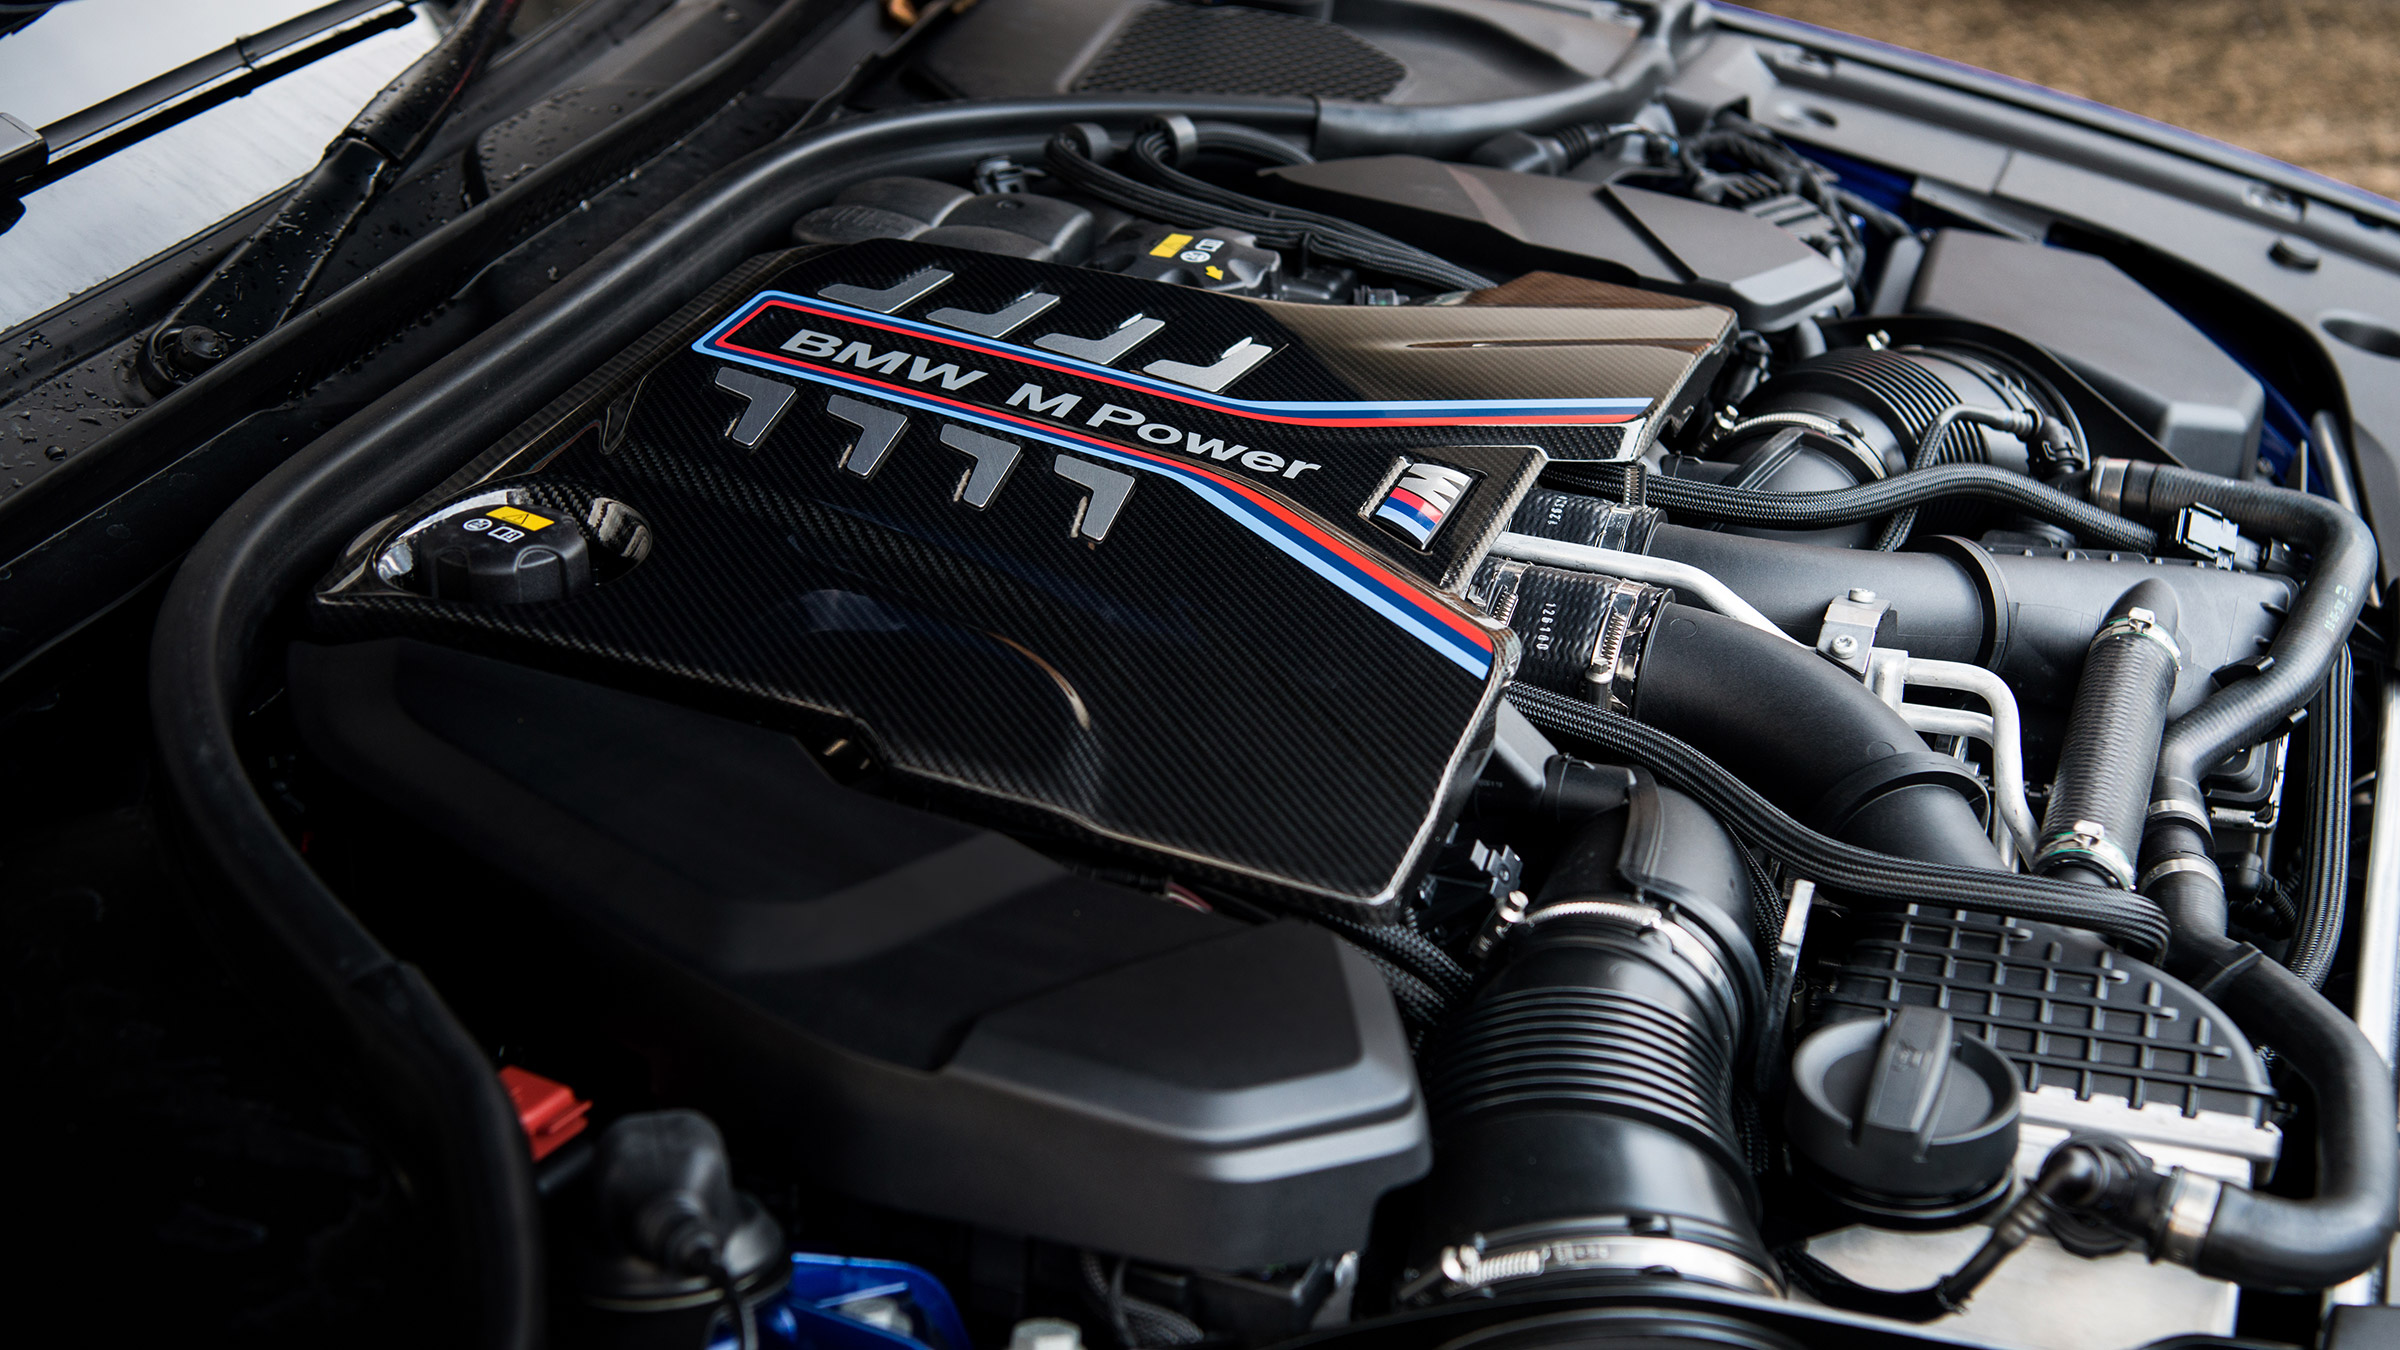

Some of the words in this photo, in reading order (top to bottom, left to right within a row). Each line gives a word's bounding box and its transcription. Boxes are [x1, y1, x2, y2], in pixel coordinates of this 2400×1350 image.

[781, 329, 989, 391] BMW
[1005, 383, 1083, 418] M
[1085, 402, 1322, 480] Power
[1536, 603, 1557, 651] 126100
